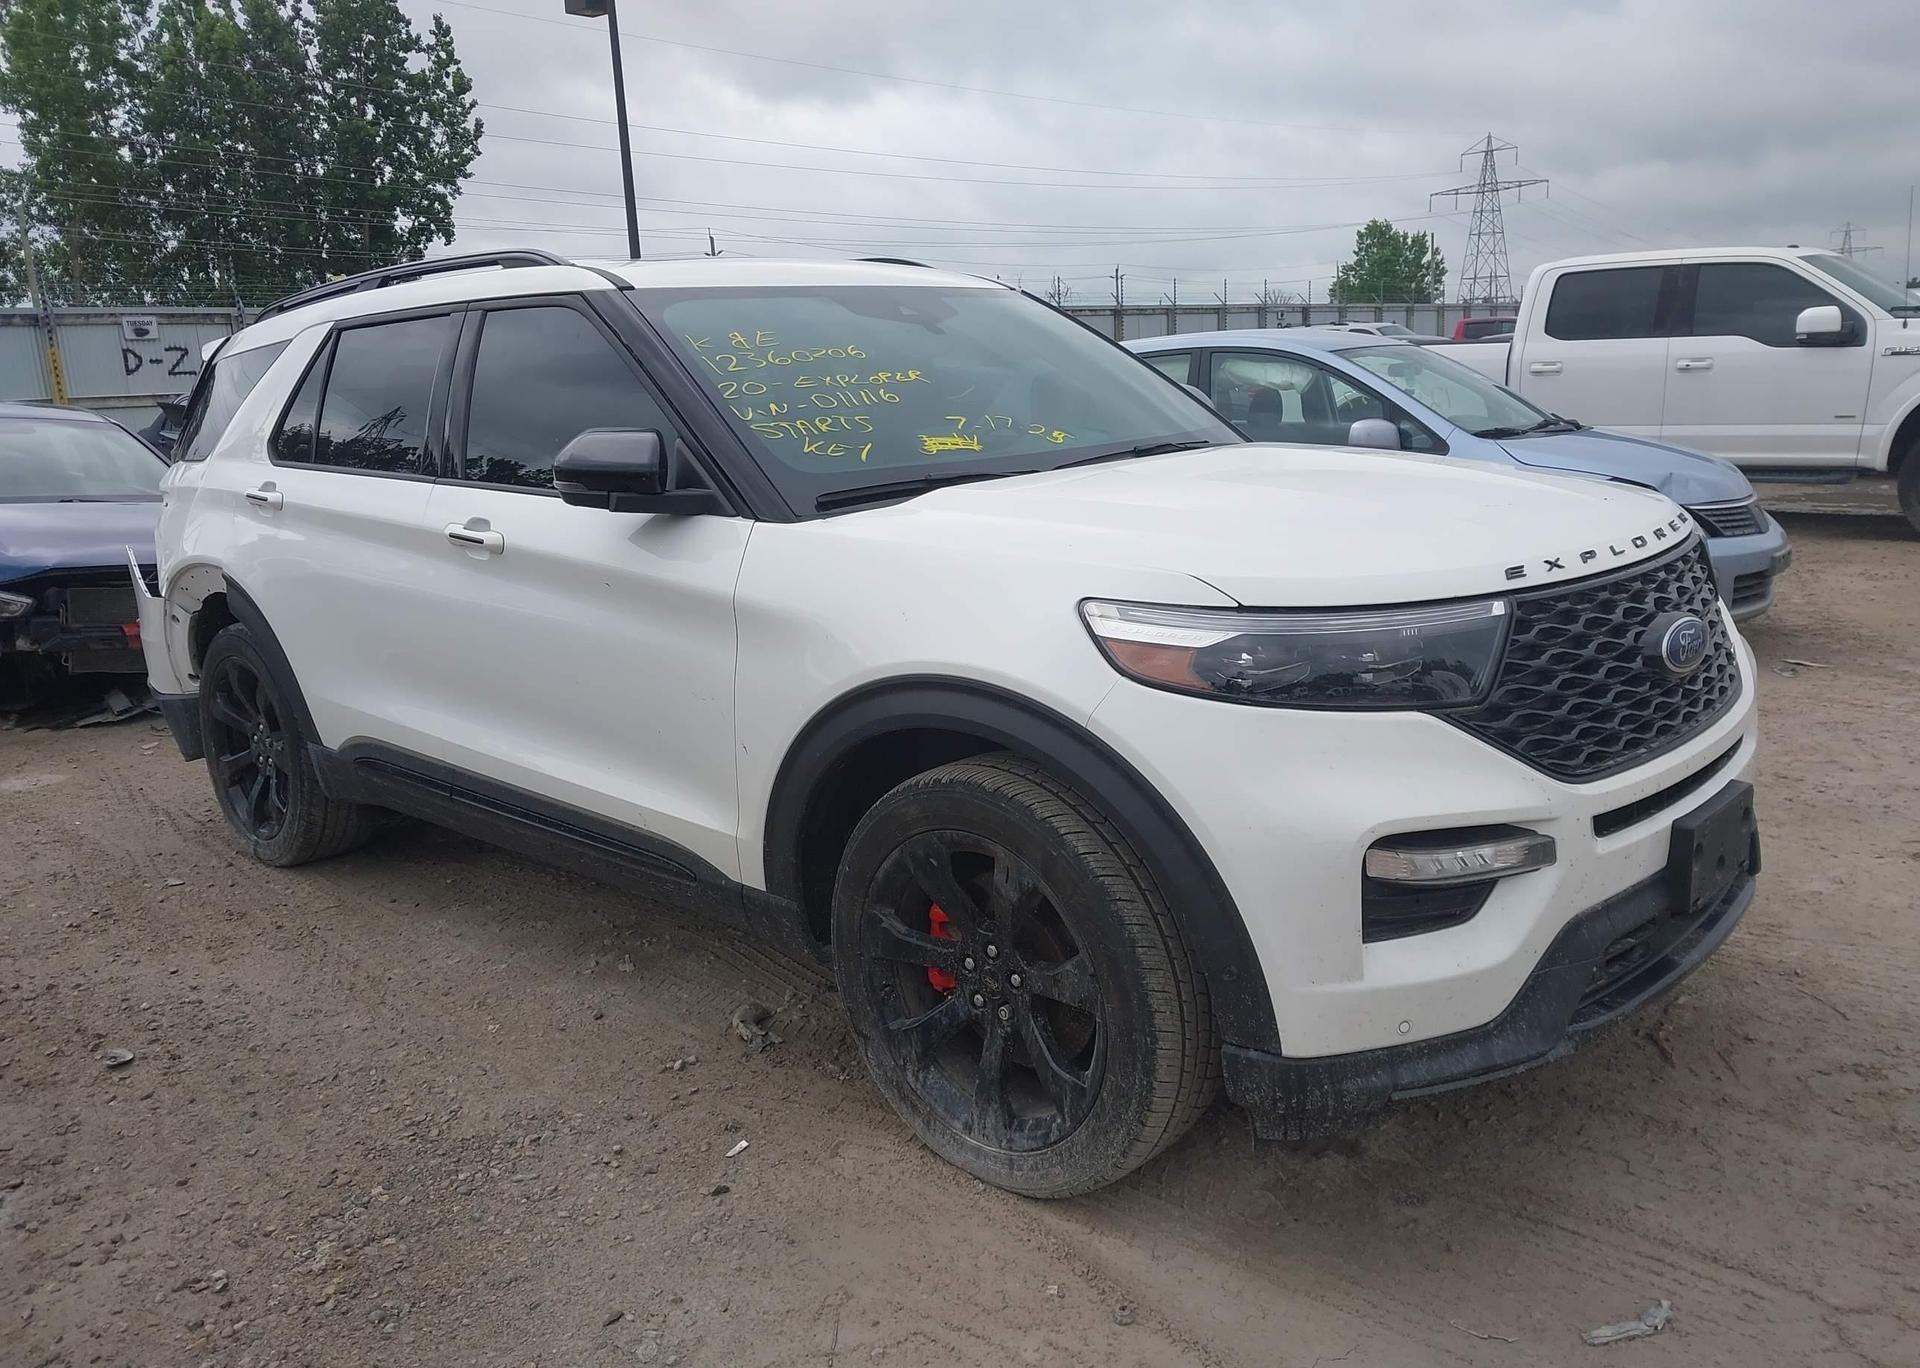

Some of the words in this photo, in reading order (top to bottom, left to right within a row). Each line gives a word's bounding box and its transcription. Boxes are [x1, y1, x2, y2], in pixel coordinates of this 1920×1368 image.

[702, 344, 867, 376] 12360206
[750, 415, 874, 439] STARTS
[803, 436, 873, 464] KEY
[1504, 512, 1689, 581] EXPLORER
[1679, 628, 1703, 661] Ford
